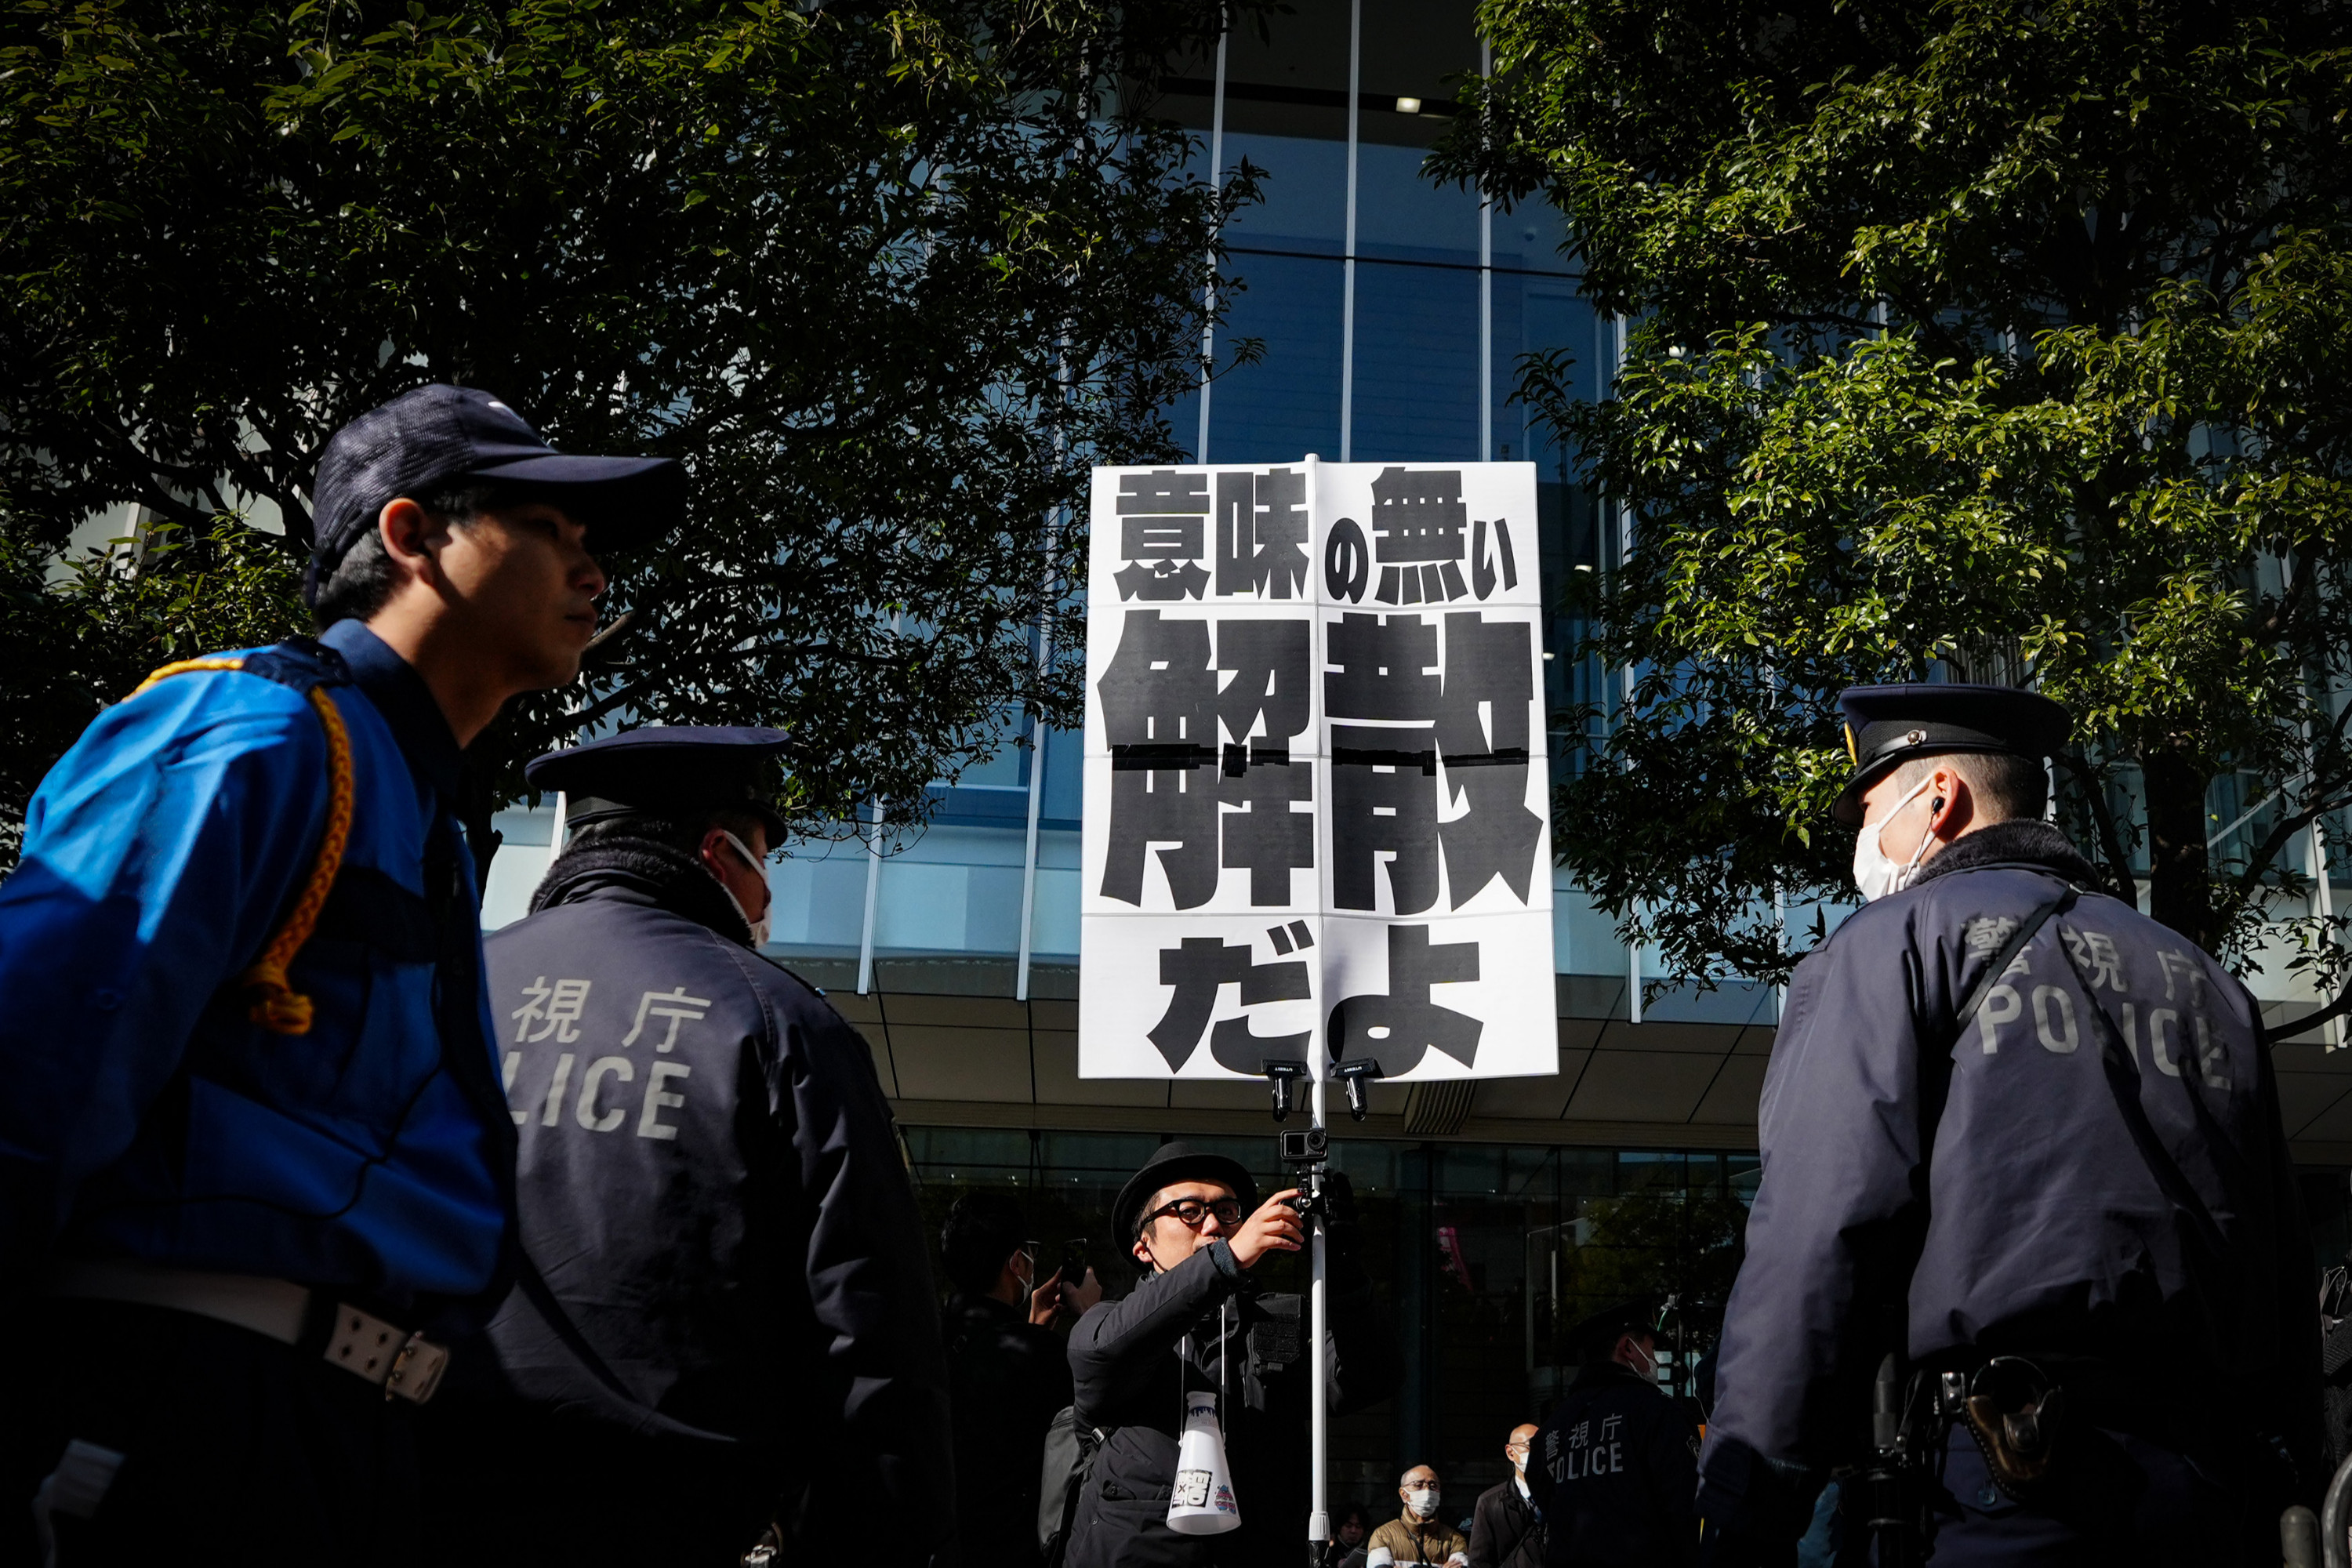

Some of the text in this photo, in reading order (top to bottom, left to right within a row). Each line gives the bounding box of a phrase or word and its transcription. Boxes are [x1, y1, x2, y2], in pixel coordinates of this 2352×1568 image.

[1114, 468, 1518, 604] 意味の無い
[1096, 608, 1544, 916] 解散
[511, 975, 712, 1053] 視庁
[1145, 919, 1484, 1079] だよ
[1977, 984, 2232, 1091] POICE
[1544, 1413, 1623, 1461] 警視庁
